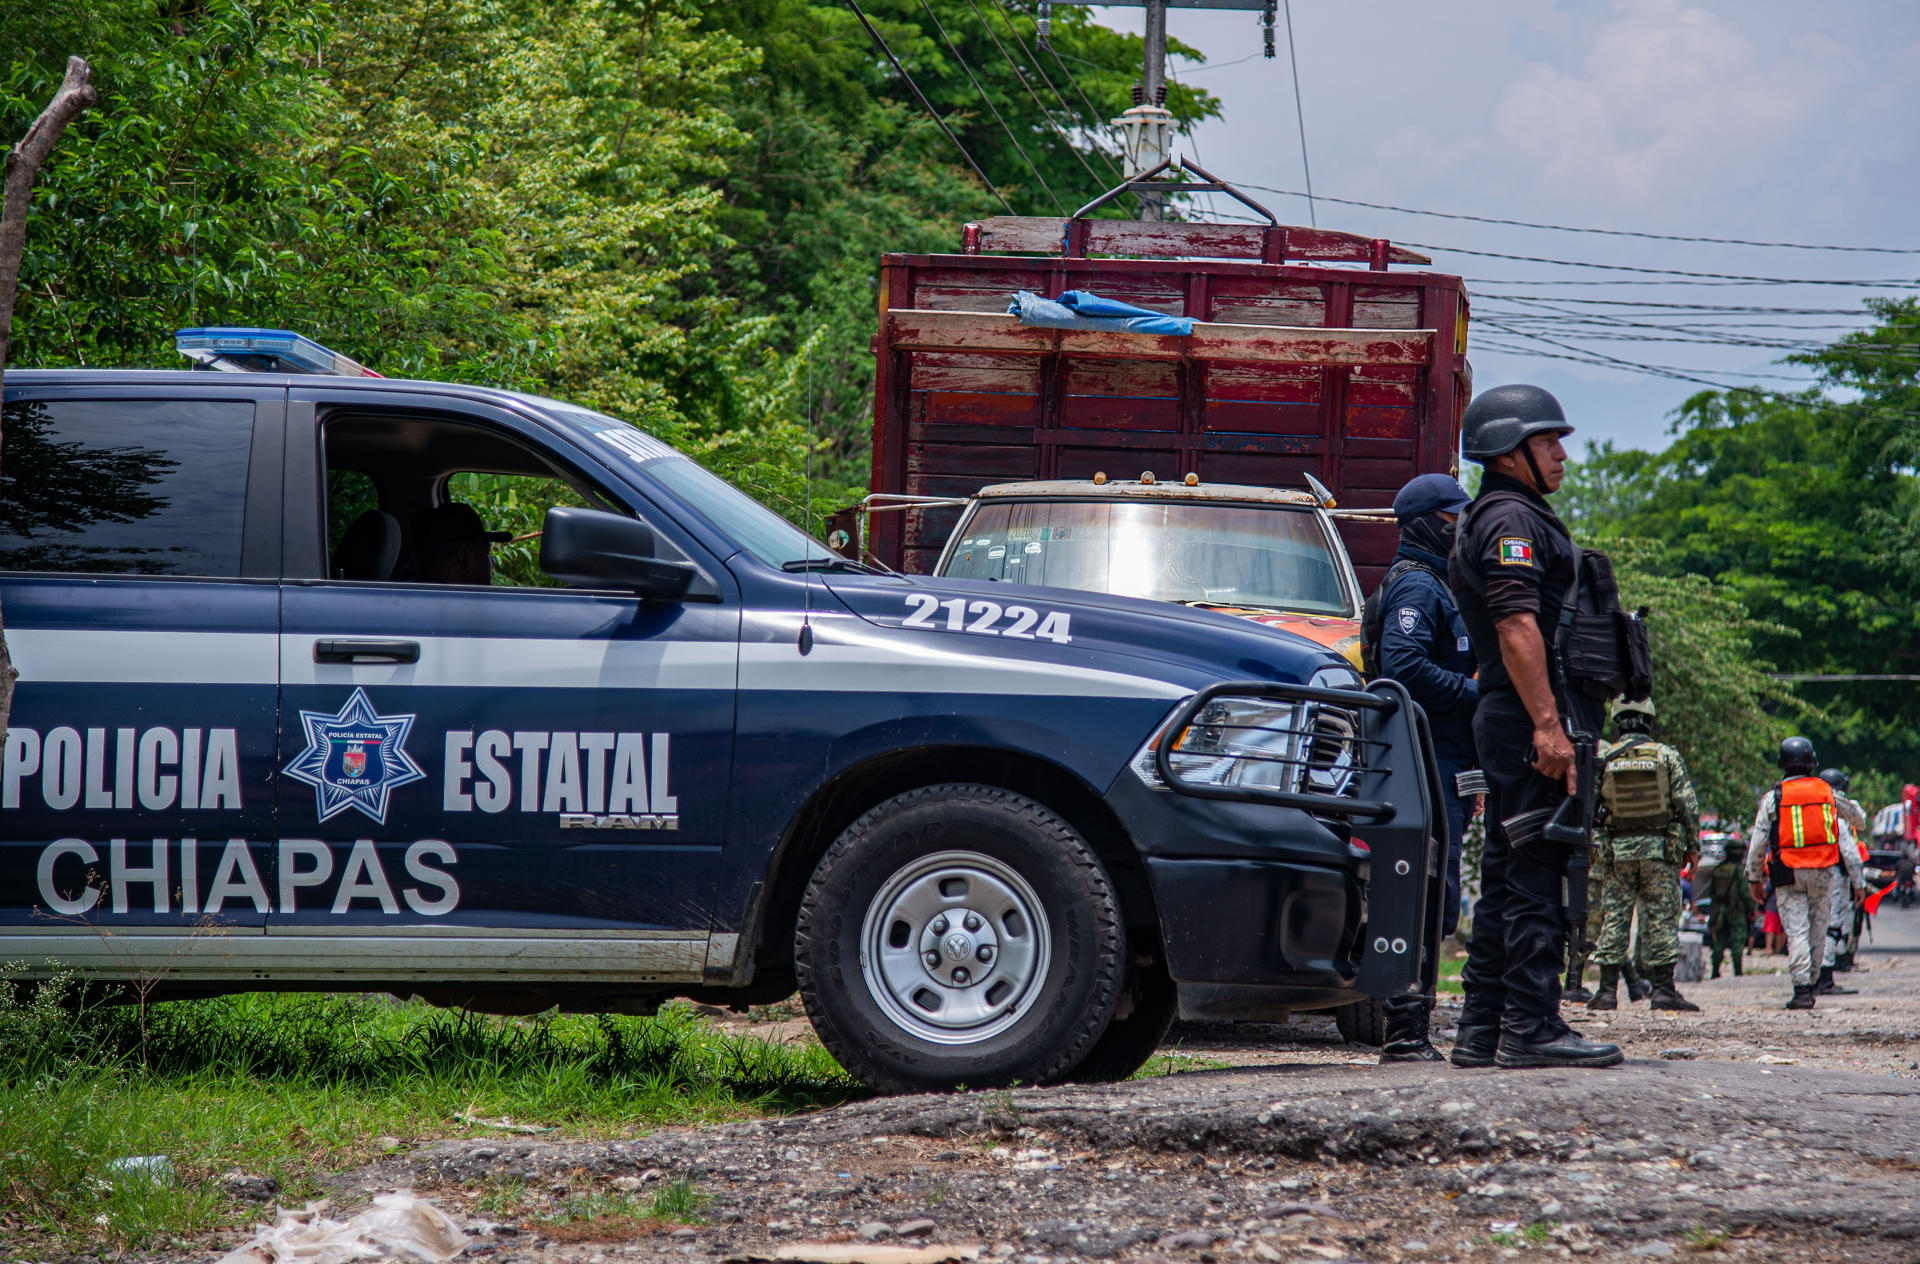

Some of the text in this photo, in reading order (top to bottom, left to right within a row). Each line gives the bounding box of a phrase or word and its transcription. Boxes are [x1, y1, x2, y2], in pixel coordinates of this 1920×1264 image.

[1503, 539, 1529, 548] CHIAPAS
[902, 593, 1072, 644] 21224
[2, 726, 678, 814] POLICIA ESTATAL
[559, 813, 679, 830] RAM
[37, 838, 460, 916] CHIAPAS
